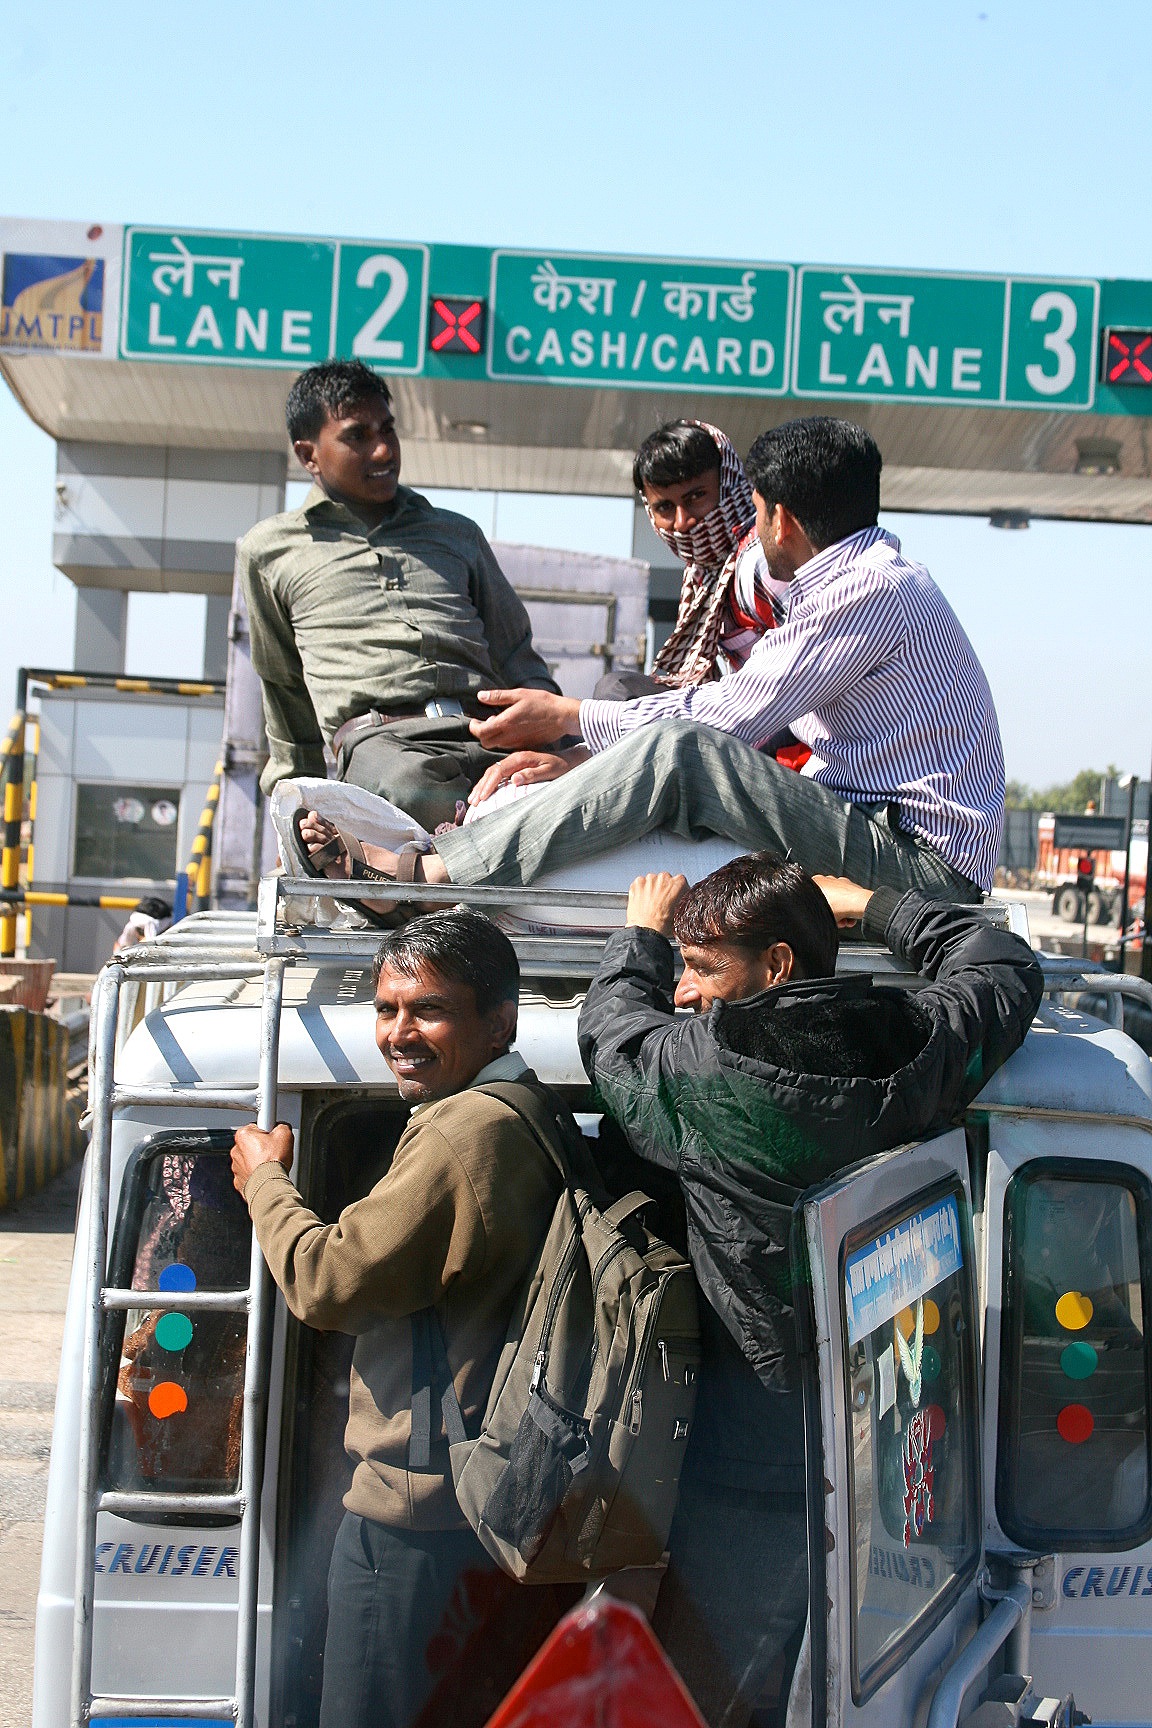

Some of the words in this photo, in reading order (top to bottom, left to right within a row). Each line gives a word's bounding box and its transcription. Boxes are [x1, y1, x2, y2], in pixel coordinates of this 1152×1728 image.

[150, 237, 243, 299] लेन
[532, 261, 615, 316] कैश
[631, 280, 647, 317] /
[662, 272, 757, 322] कार्ड
[149, 303, 312, 353] LANE
[352, 255, 408, 359] 2
[821, 275, 914, 337] लेन
[506, 327, 776, 377] CASH/CARD
[820, 342, 983, 390] LANE
[1026, 292, 1078, 394] 3
[95, 1542, 239, 1577] CRUISER
